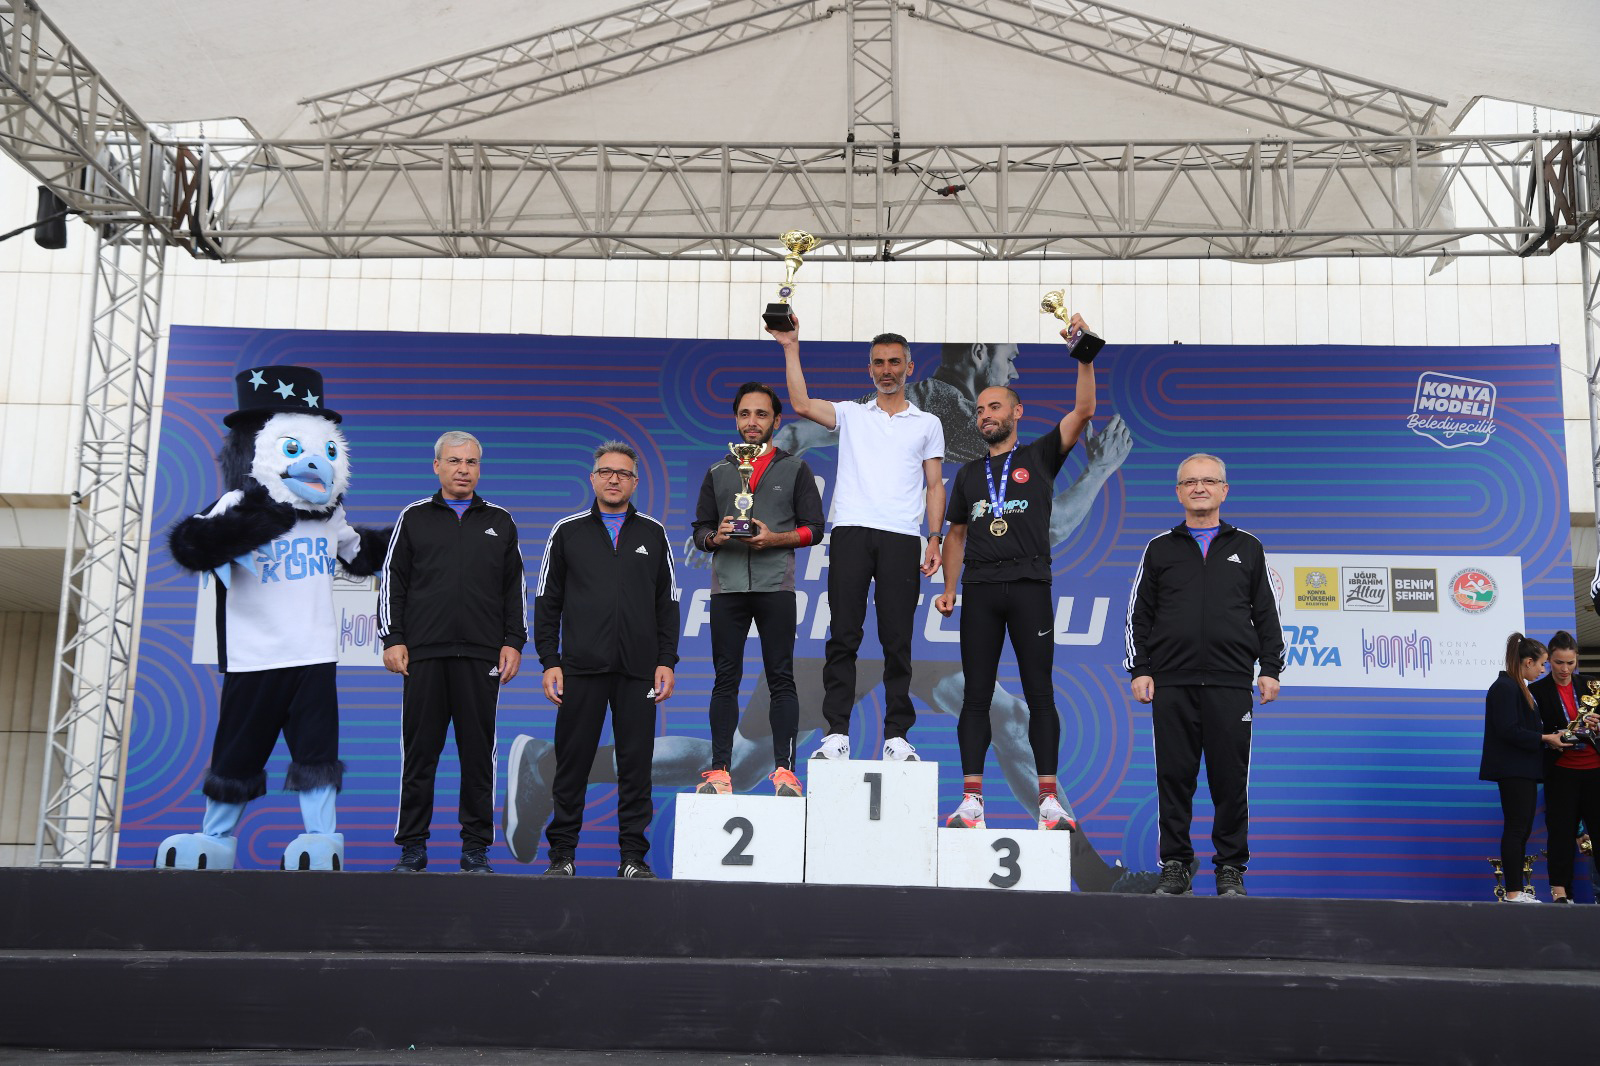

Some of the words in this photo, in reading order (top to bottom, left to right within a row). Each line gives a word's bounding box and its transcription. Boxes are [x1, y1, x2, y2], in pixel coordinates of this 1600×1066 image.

[1422, 381, 1491, 403] KONYA
[1406, 413, 1497, 438] Belediyecilik
[1353, 570, 1377, 579] UĞUR
[1346, 584, 1386, 602] Altay
[1394, 579, 1435, 591] BENİM
[1395, 590, 1435, 602] ŞEHRİM
[1439, 649, 1466, 657] YARI
[864, 772, 882, 820] 1
[721, 816, 755, 866] 2
[988, 837, 1022, 889] 3
